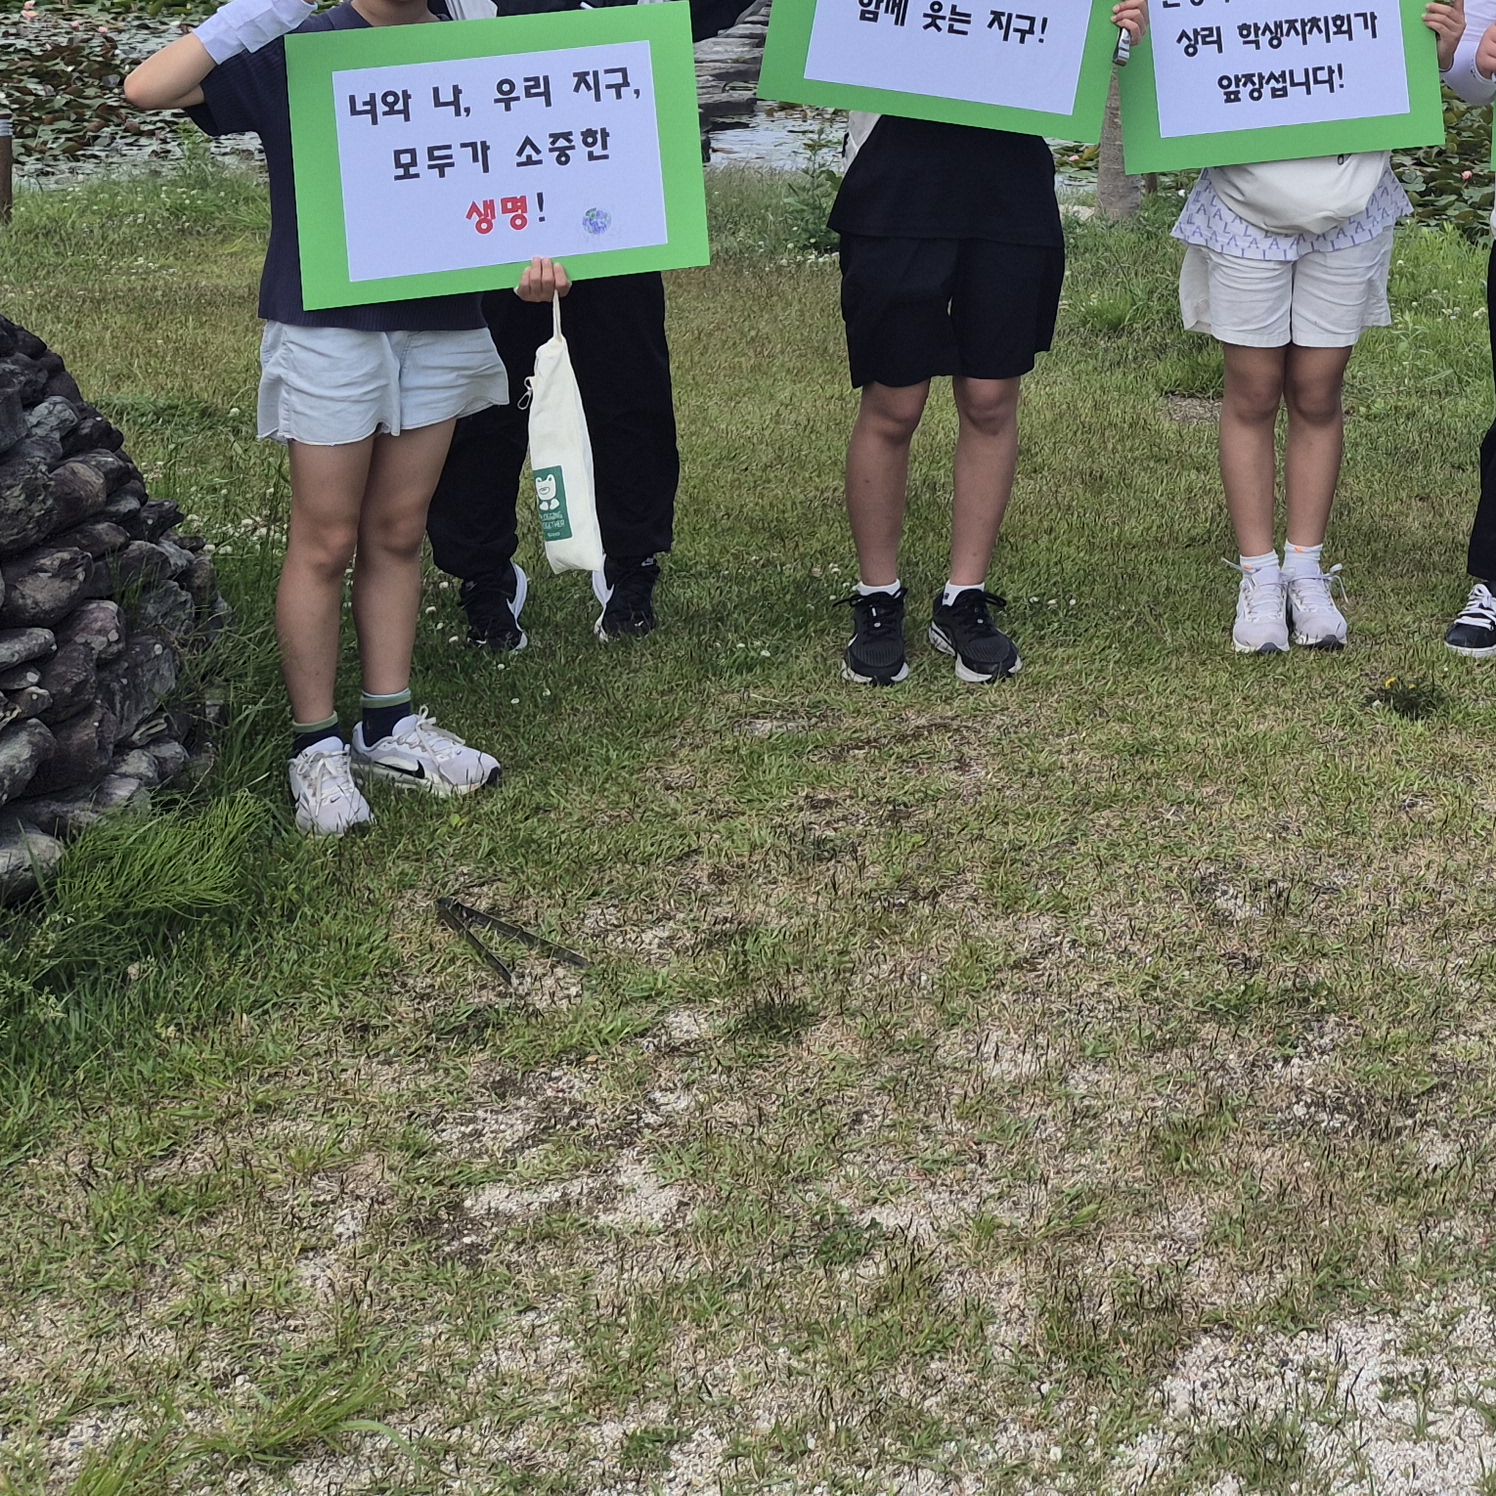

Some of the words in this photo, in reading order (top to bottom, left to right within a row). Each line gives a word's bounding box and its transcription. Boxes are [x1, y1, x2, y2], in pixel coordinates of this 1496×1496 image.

[923, 1, 971, 35] 웃는
[987, 10, 1048, 44] 지구!
[1176, 26, 1223, 57] 상리
[1237, 12, 1377, 50] 학생자치회가
[349, 89, 411, 125] 너와
[432, 85, 470, 117] 나,
[494, 75, 552, 112] 우리
[573, 67, 640, 102] 지구,
[1218, 63, 1344, 103] 앞장섭니다!
[394, 141, 490, 181] 모두가
[516, 127, 610, 167] 소중한
[466, 192, 545, 234] 생명!
